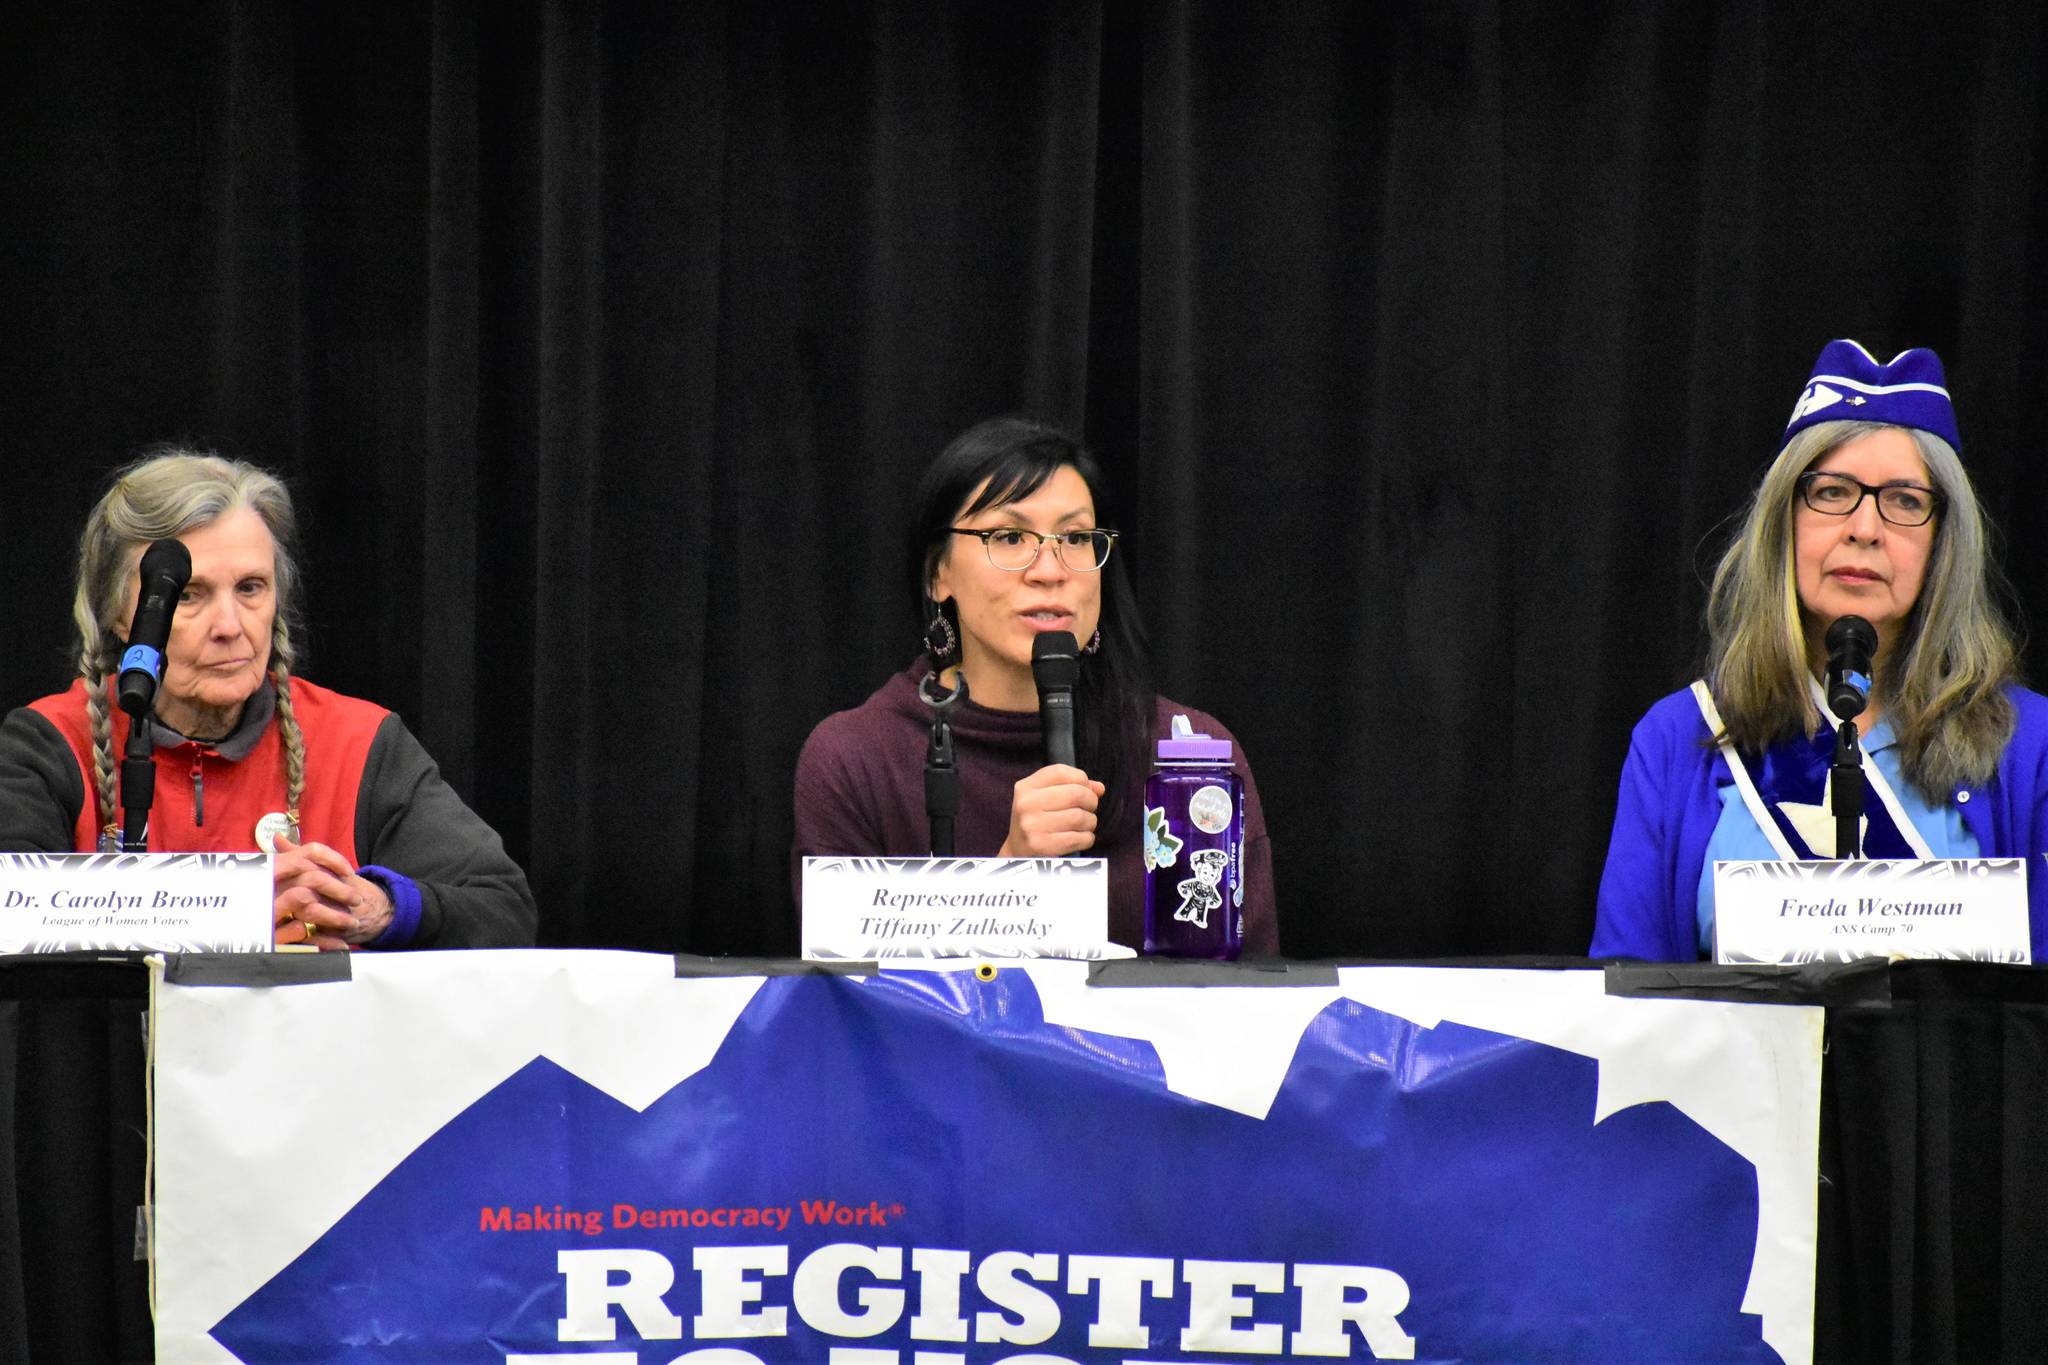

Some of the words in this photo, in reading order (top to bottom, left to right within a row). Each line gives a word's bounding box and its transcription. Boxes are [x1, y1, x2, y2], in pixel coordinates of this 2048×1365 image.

[131, 649, 147, 665] 2
[4, 889, 39, 908] Dr.
[50, 889, 142, 913] Carolyn
[152, 889, 228, 908] Brown
[872, 888, 1038, 911] Representative
[1779, 898, 1847, 917] Freda
[1857, 898, 1963, 917] Westman
[42, 915, 84, 928] League
[89, 915, 101, 928] of
[104, 915, 148, 926] Women
[152, 915, 189, 926] Voters
[859, 917, 941, 939] Tiffany
[948, 917, 1052, 939] Zulkosky
[1831, 924, 1858, 934] ANS
[1861, 923, 1896, 936] Camp
[1900, 924, 1913, 934] 70
[479, 1205, 604, 1235] Making
[613, 1203, 791, 1231] Democracy
[557, 1243, 1416, 1361] REGISTER
